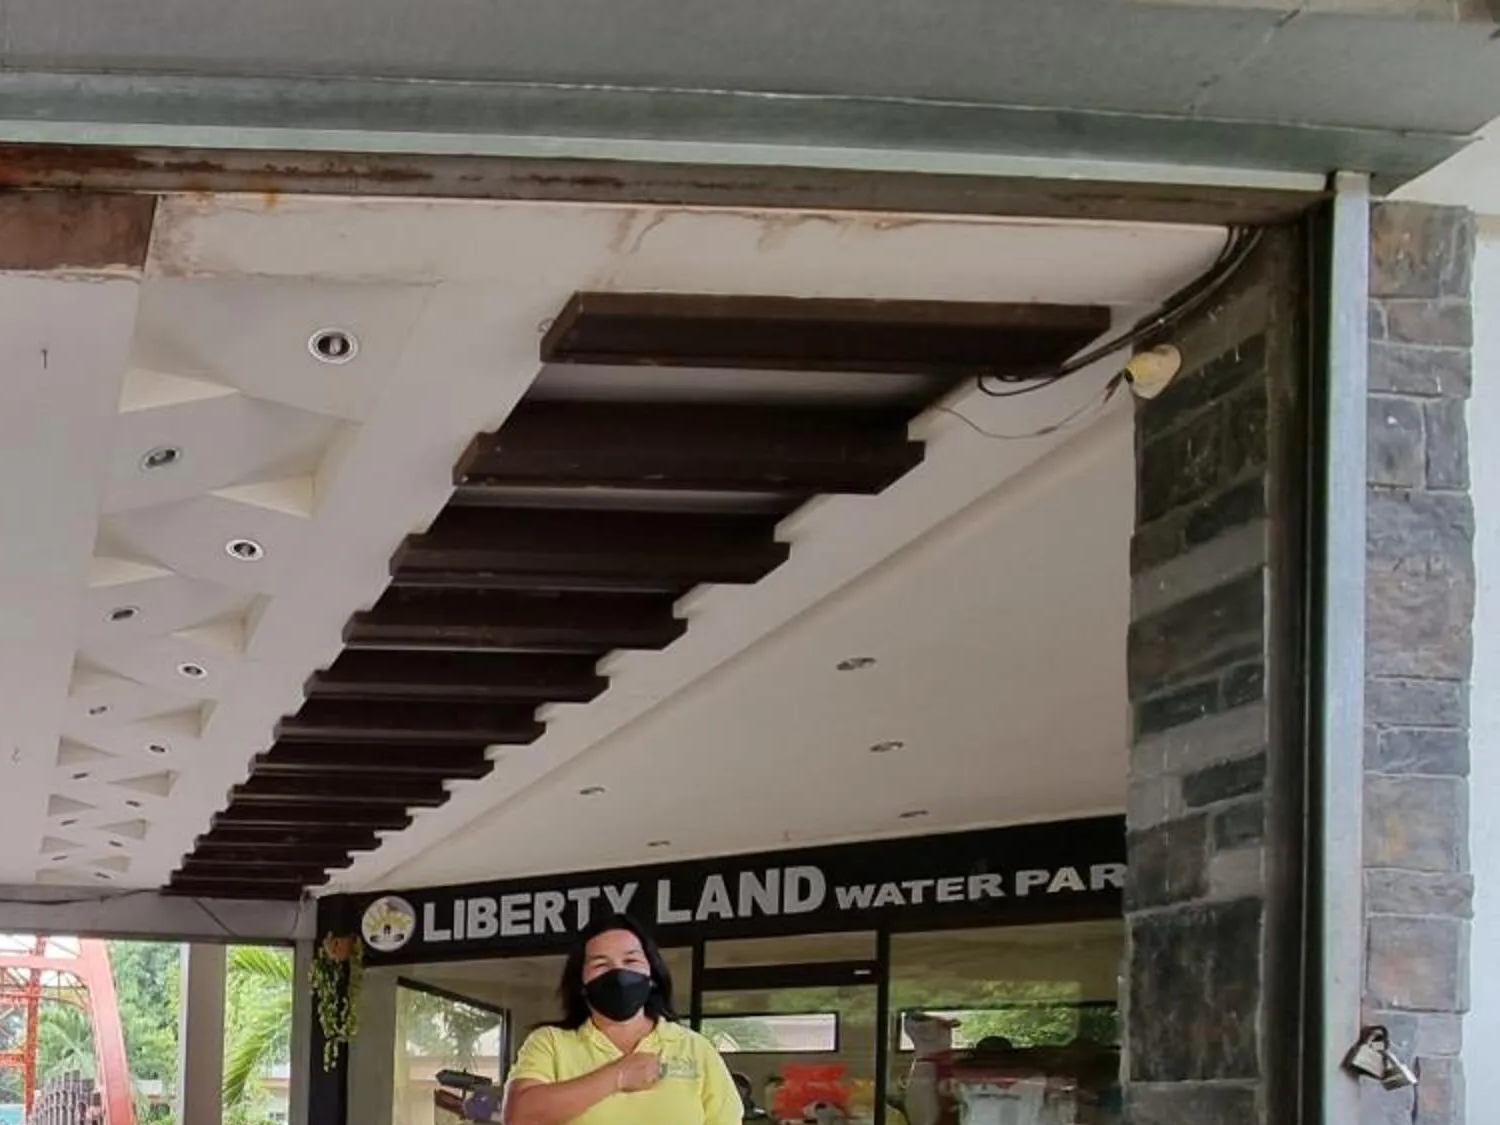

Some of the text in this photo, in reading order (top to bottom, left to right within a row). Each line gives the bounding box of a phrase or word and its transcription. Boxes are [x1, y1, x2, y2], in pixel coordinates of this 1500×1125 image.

[423, 863, 1128, 942] LIBERTY LAND WATER PAR
